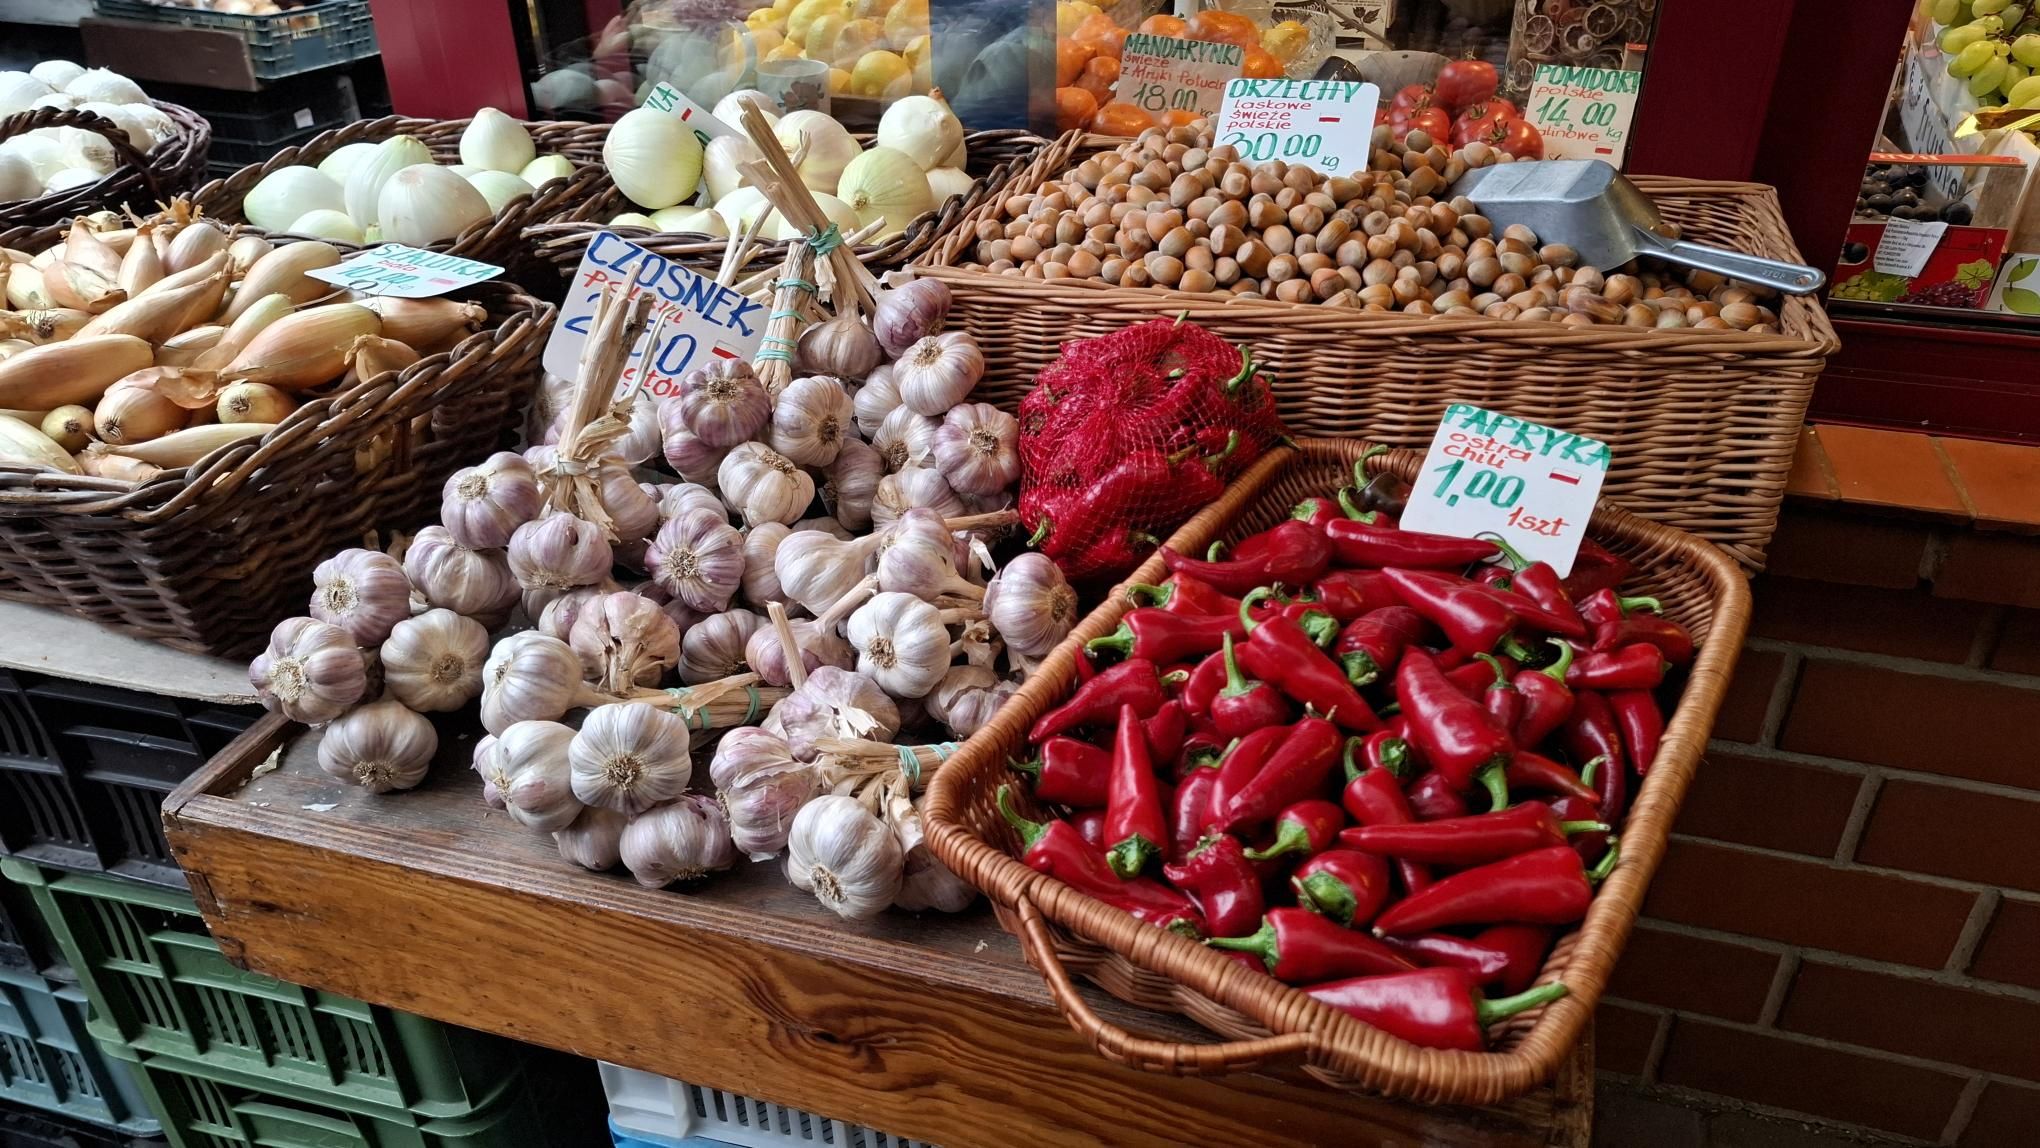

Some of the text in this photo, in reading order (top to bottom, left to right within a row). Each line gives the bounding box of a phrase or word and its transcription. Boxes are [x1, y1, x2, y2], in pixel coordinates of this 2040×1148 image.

[1125, 33, 1243, 66] MANDARYNKI
[1132, 65, 1172, 85] Afryki
[1228, 79, 1363, 103] ORZECHY
[1535, 86, 1604, 101] polskie
[1234, 99, 1312, 111] laskowe
[1227, 120, 1291, 132] polskie
[1538, 126, 1623, 142] alinowe kg
[1321, 155, 1339, 171] kg
[373, 244, 497, 279] SZALOTKA
[587, 231, 763, 337] CZOSNEK
[1444, 403, 1613, 471] PAPRYKA
[1450, 433, 1532, 462] ostra
[1433, 459, 1526, 509] 1,00
